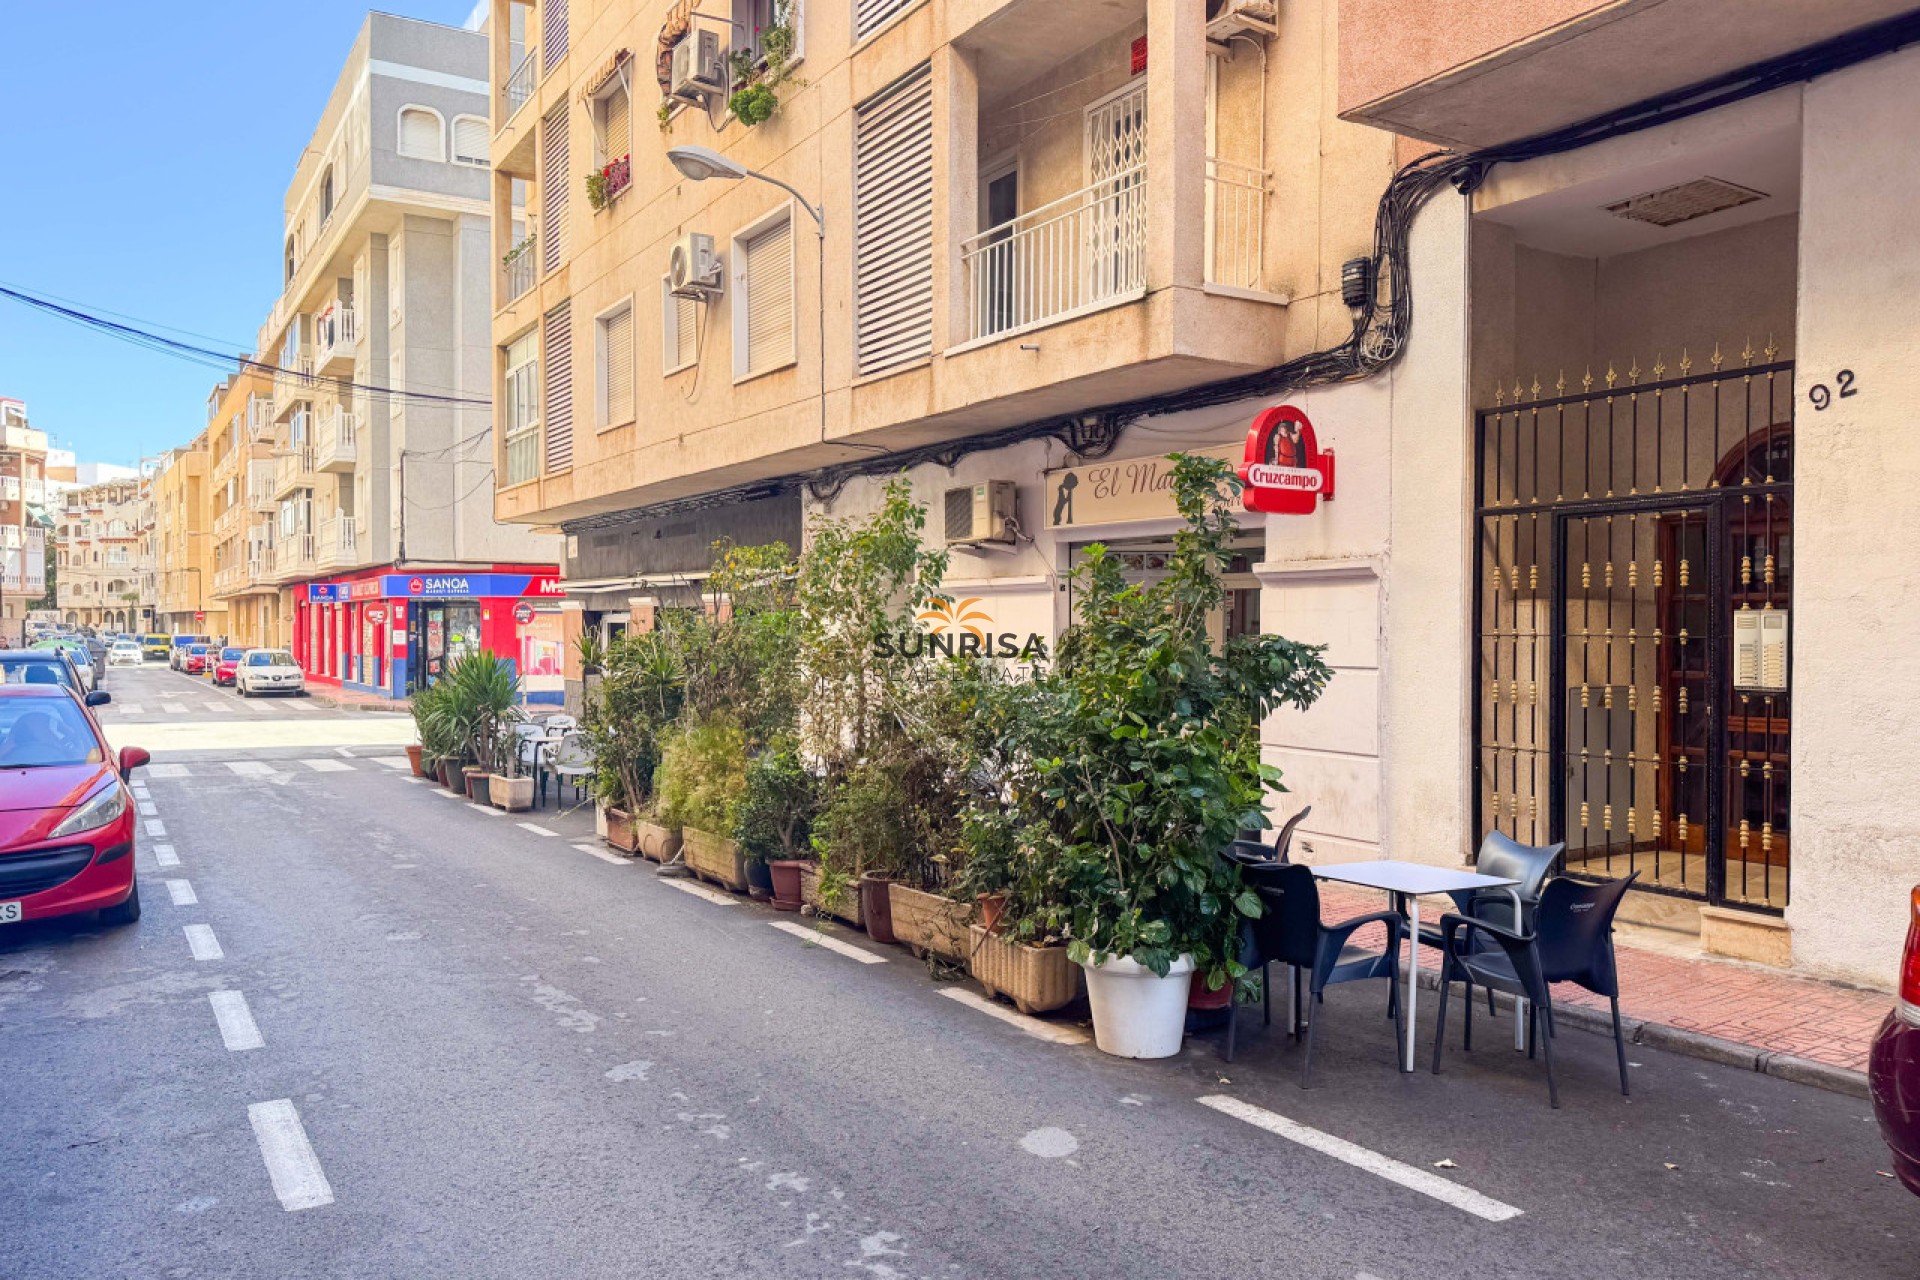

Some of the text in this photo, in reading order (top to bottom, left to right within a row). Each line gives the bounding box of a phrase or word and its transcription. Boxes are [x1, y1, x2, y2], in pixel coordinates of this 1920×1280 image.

[1809, 368, 1857, 411] 92
[1088, 466, 1121, 499] El
[1253, 467, 1317, 489] Cruzcampo
[425, 578, 469, 589] SANOA
